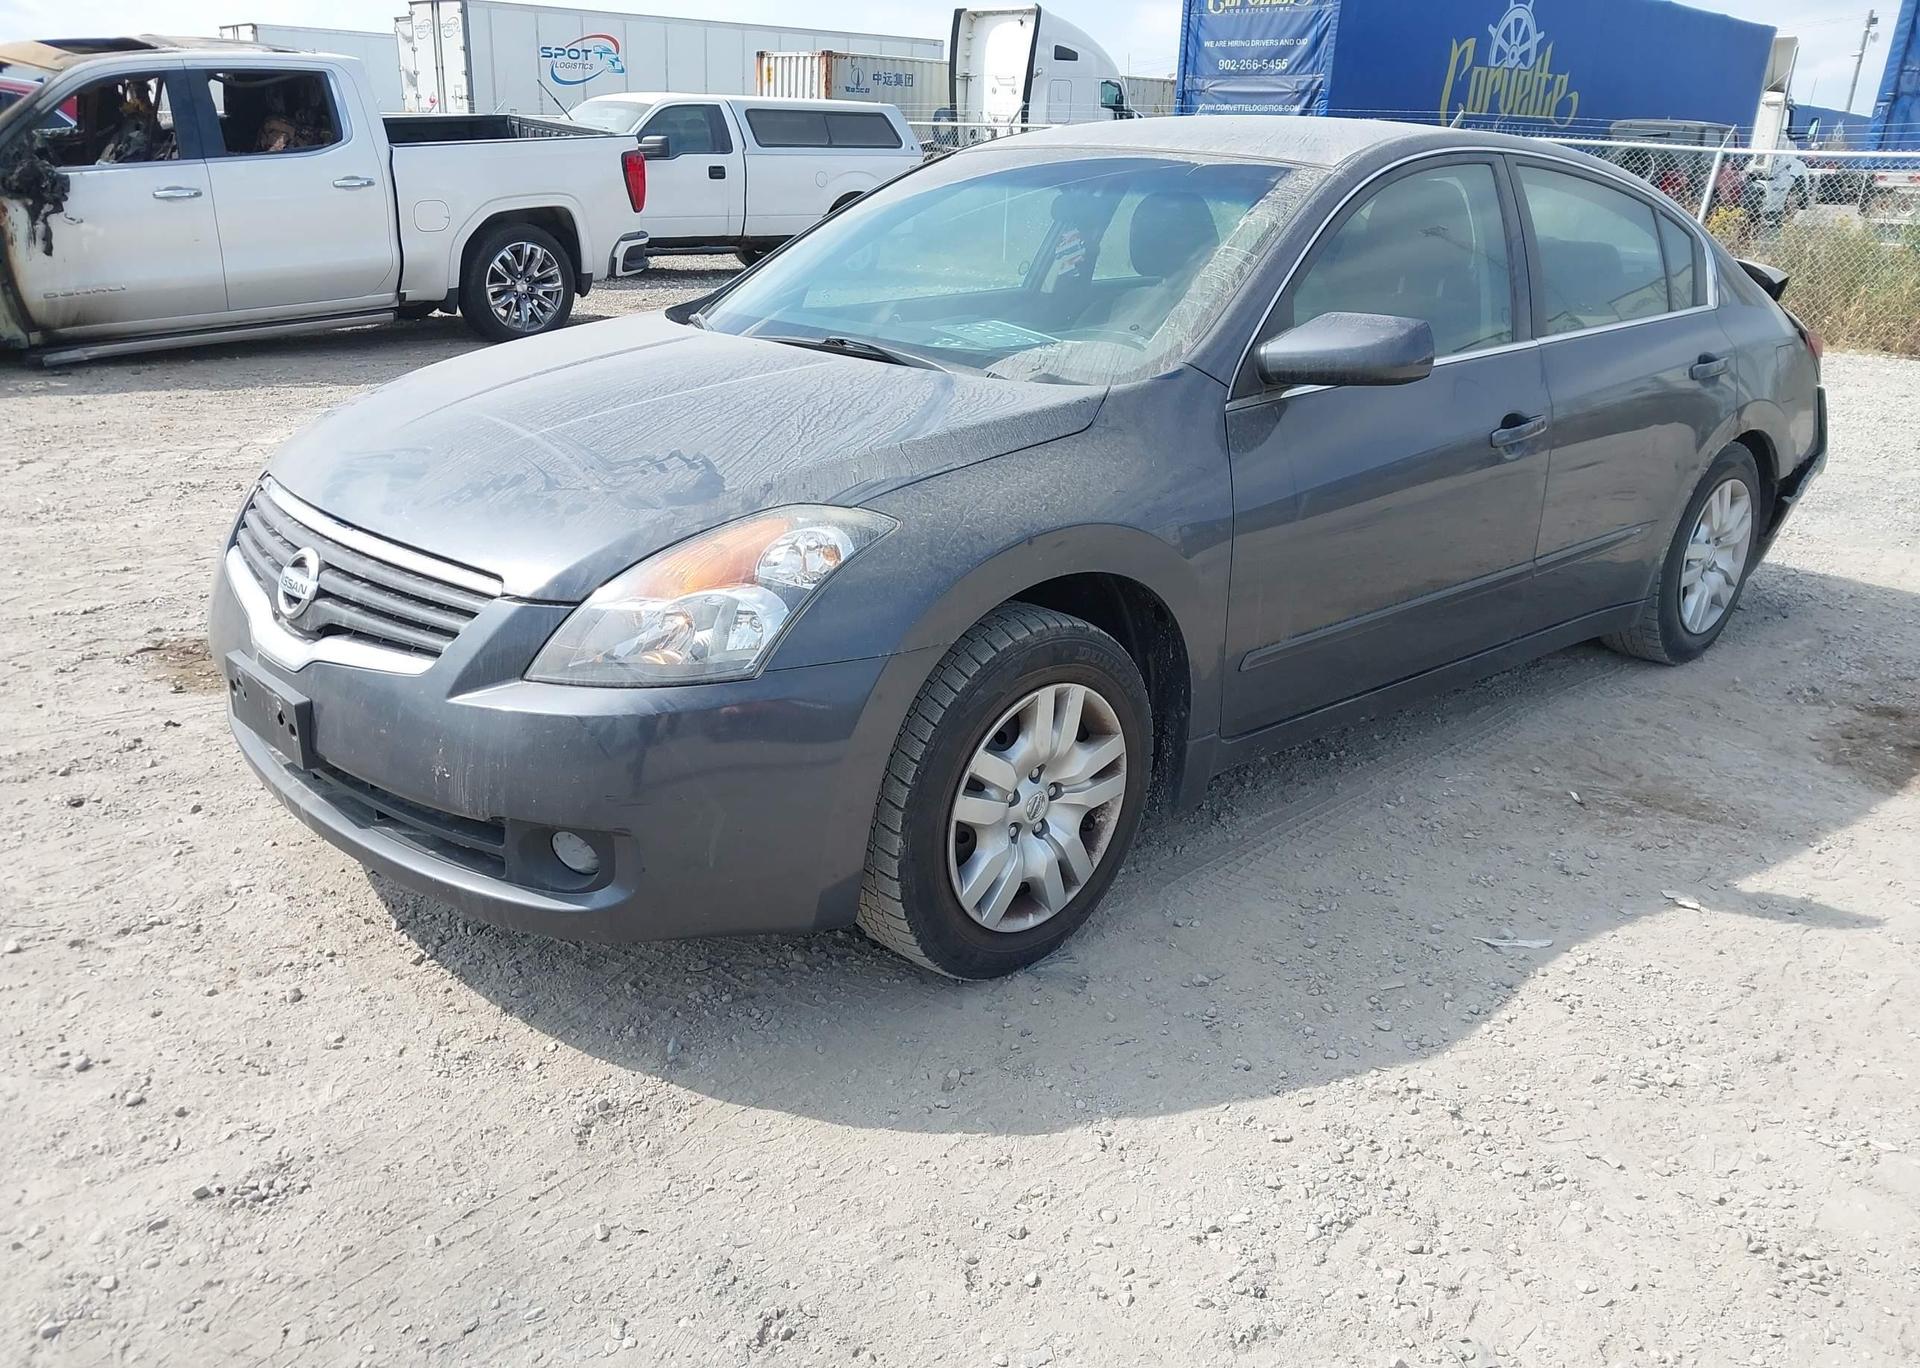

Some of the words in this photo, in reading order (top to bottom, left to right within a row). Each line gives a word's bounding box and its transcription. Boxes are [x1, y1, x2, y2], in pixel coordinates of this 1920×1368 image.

[1204, 40, 1214, 48] WE
[1251, 39, 1278, 47] DRIVERS
[1280, 38, 1294, 46] AND
[540, 46, 592, 61] SPOT
[555, 61, 594, 70] LOGISTICS
[1218, 59, 1288, 70] 902-266-5455
[872, 71, 913, 87] 中运集团
